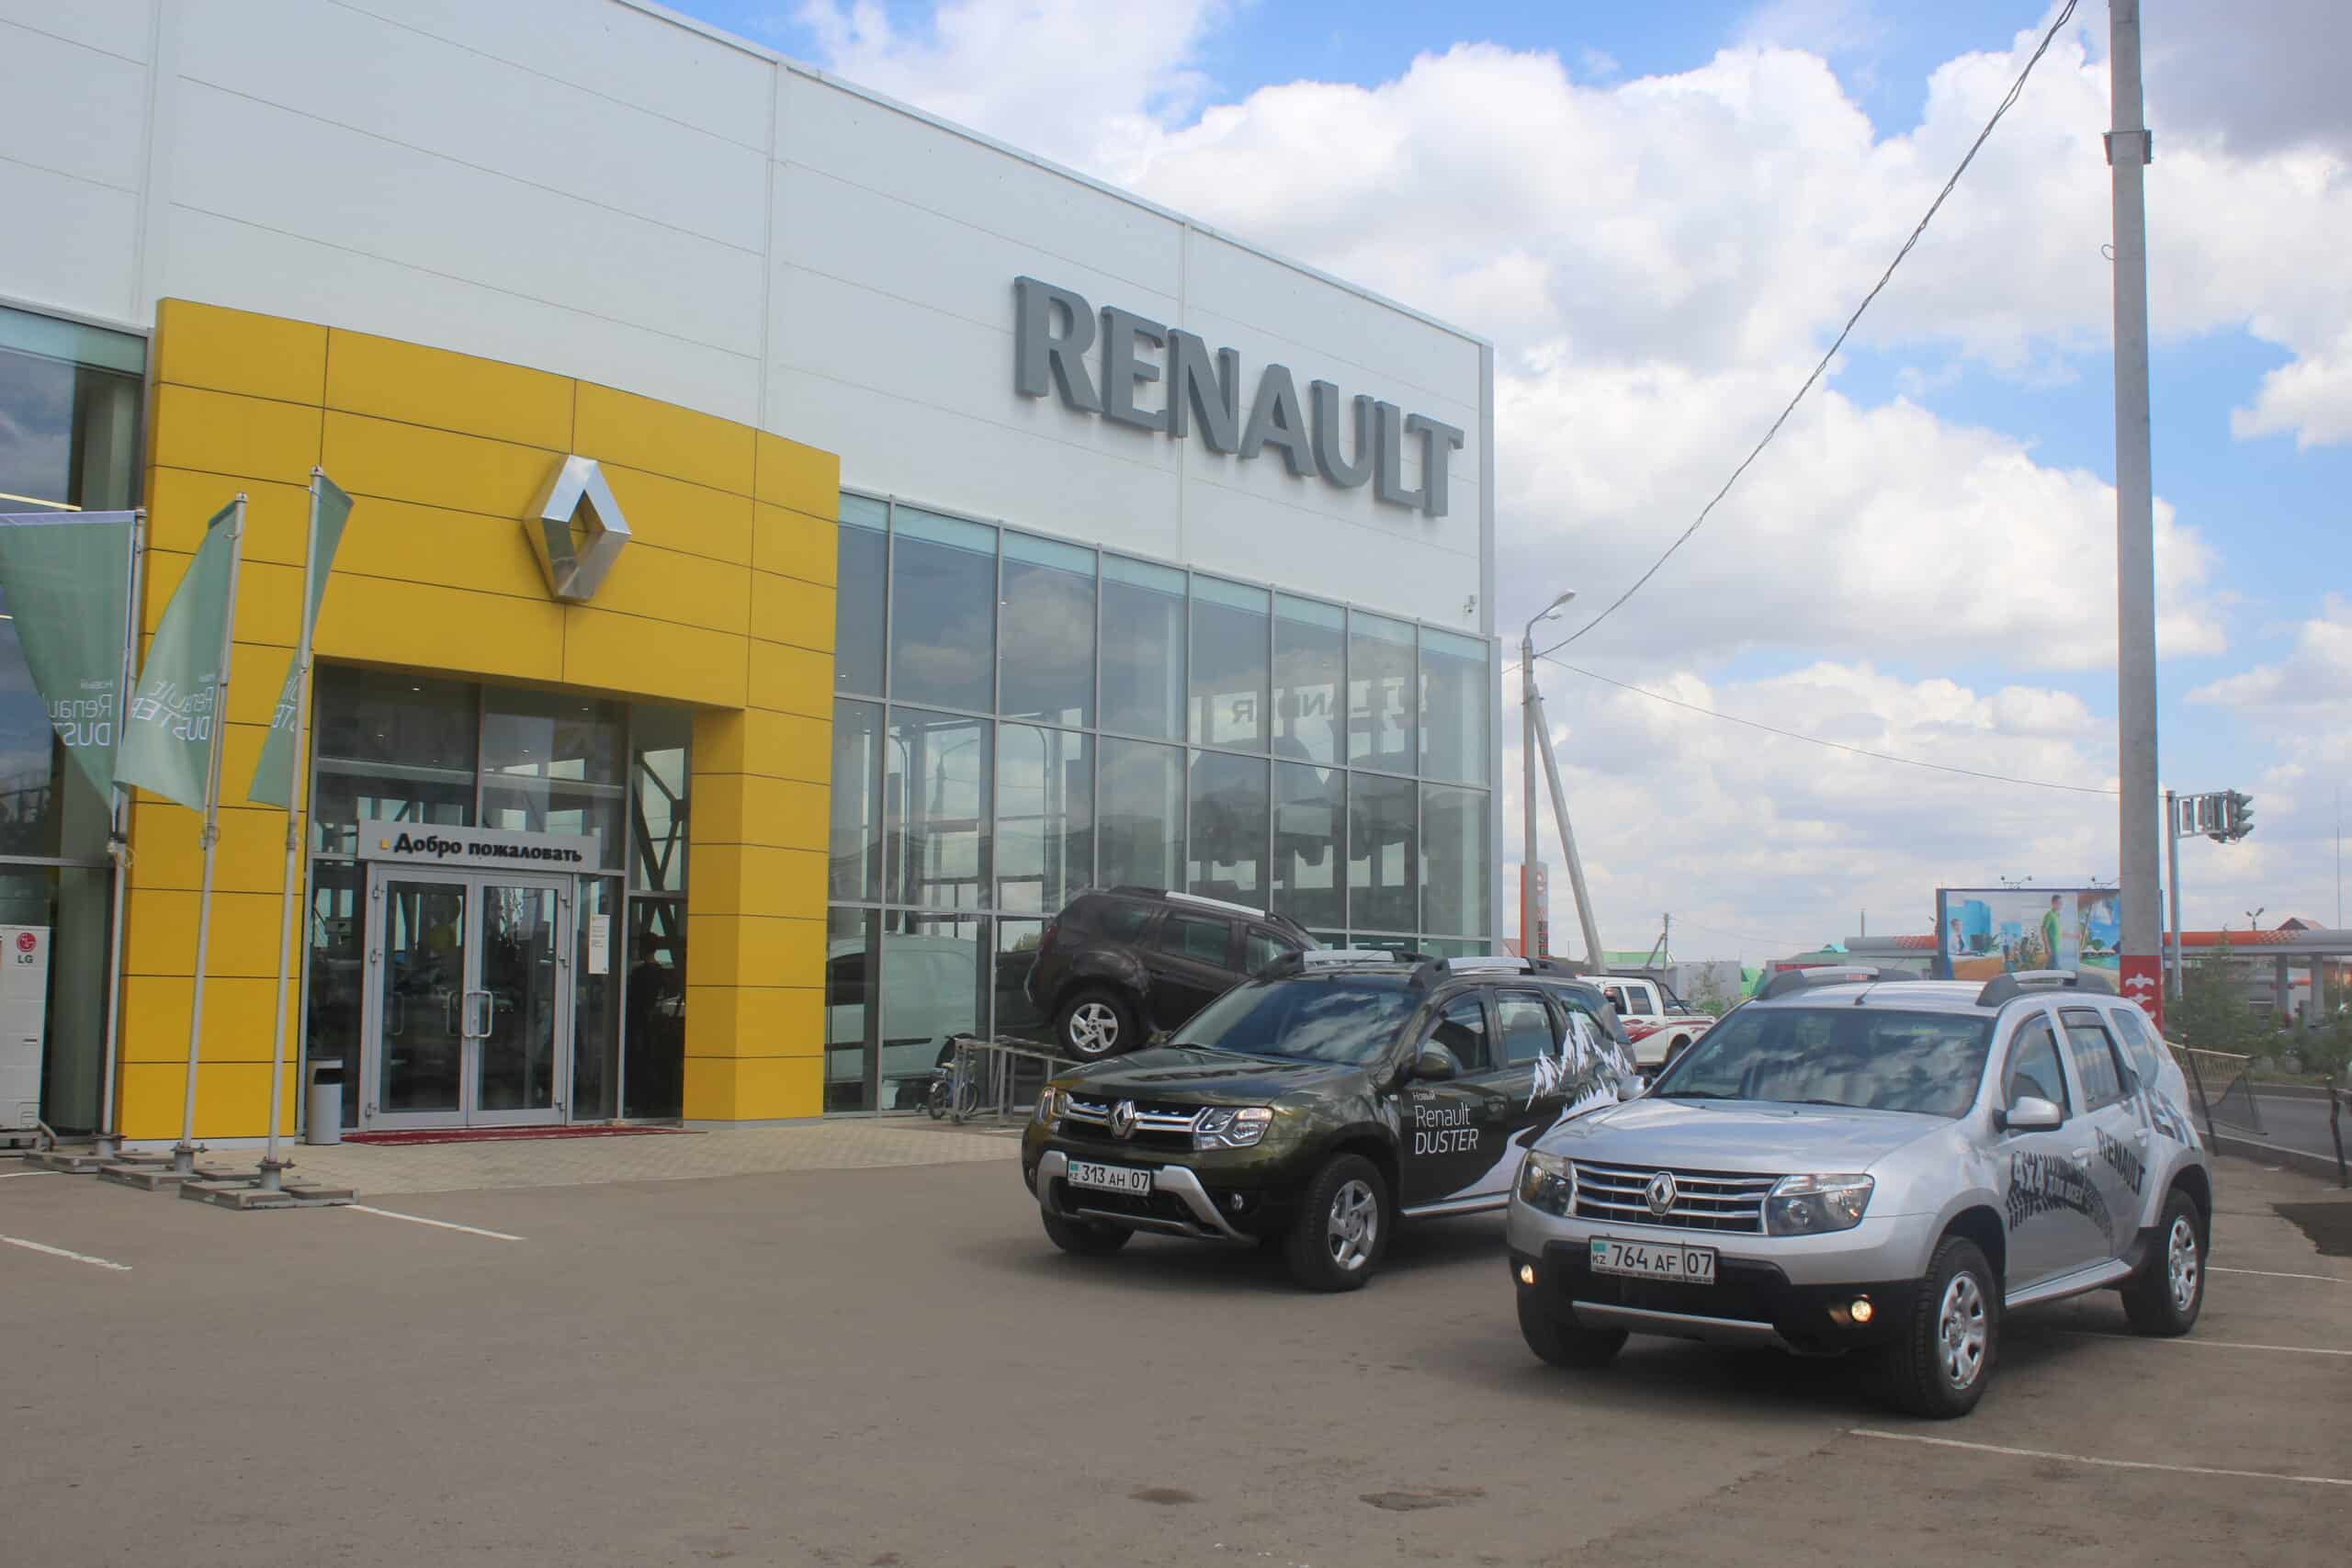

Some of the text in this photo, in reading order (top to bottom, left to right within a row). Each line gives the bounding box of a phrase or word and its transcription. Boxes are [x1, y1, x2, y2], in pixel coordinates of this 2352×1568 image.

[1014, 276, 1464, 516] RENAULT
[394, 833, 582, 862] Добро пожаловать
[17, 955, 34, 964] LG
[1414, 1102, 1471, 1128] Renault
[1415, 1129, 1479, 1154] DUSTER
[2095, 1125, 2146, 1196] RENAULT
[1081, 1164, 1105, 1183] 313
[1109, 1171, 1125, 1187] AH
[1131, 1172, 1148, 1190] 07
[1592, 1254, 1606, 1264] KZ
[1611, 1245, 1647, 1269] 764
[1655, 1255, 1677, 1271] AF
[1687, 1253, 1712, 1276] 07
